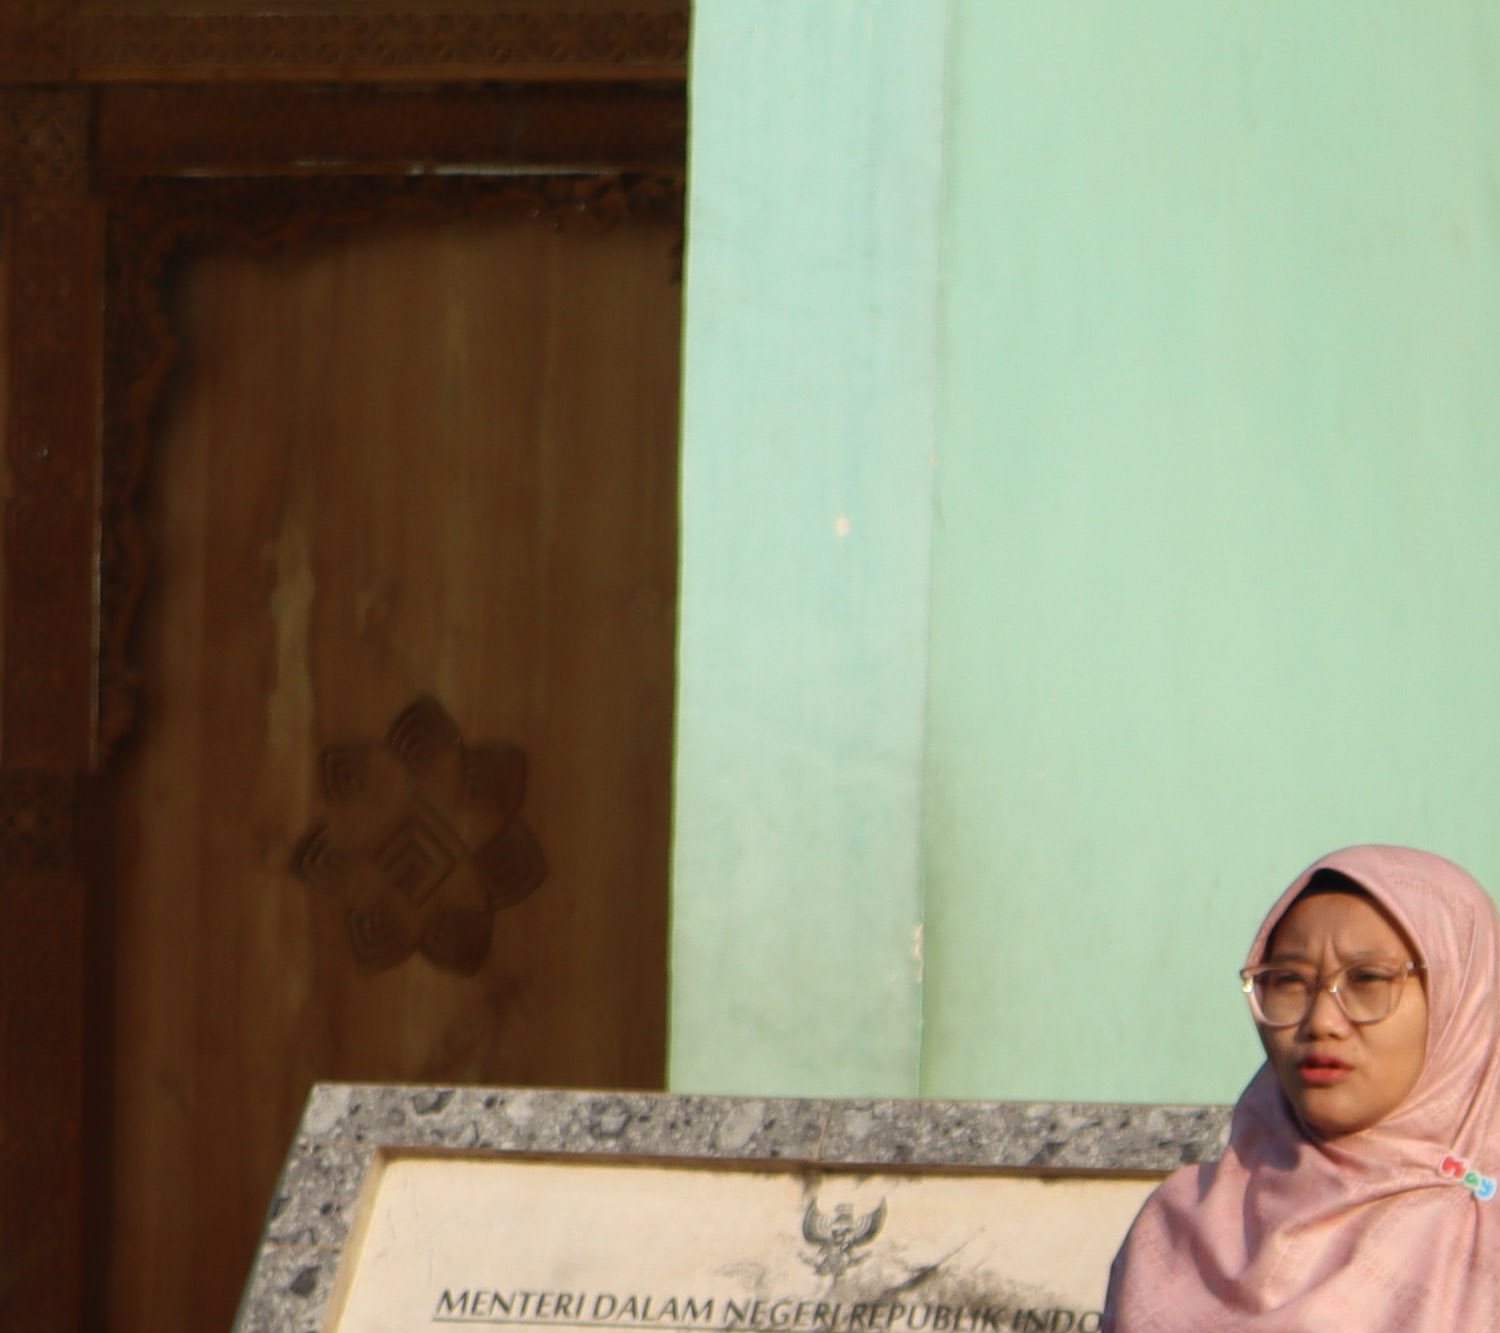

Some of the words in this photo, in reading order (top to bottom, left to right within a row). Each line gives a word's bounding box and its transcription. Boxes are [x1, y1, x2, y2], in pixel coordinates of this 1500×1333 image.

[437, 1289, 585, 1318] MENTERI
[592, 1294, 714, 1322] DALAM
[723, 1300, 841, 1328] NEGERI
[850, 1302, 1006, 1331] REPUBLIK
